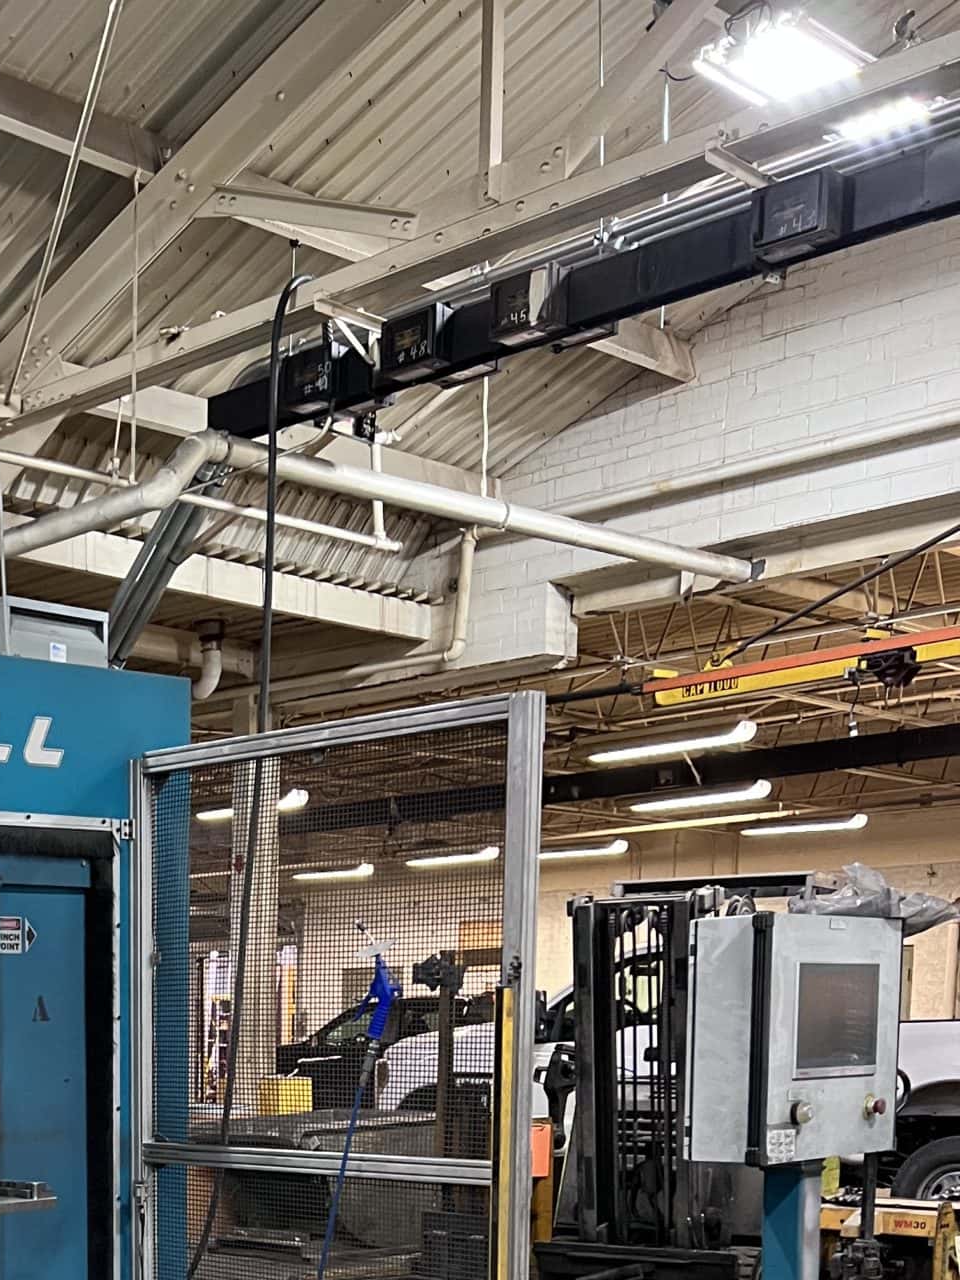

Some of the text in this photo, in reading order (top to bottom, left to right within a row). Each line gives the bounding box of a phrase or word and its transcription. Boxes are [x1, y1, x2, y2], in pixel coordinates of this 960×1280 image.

[682, 684, 704, 698] CAP
[0, 933, 20, 942] INCH
[0, 942, 20, 951] OINT
